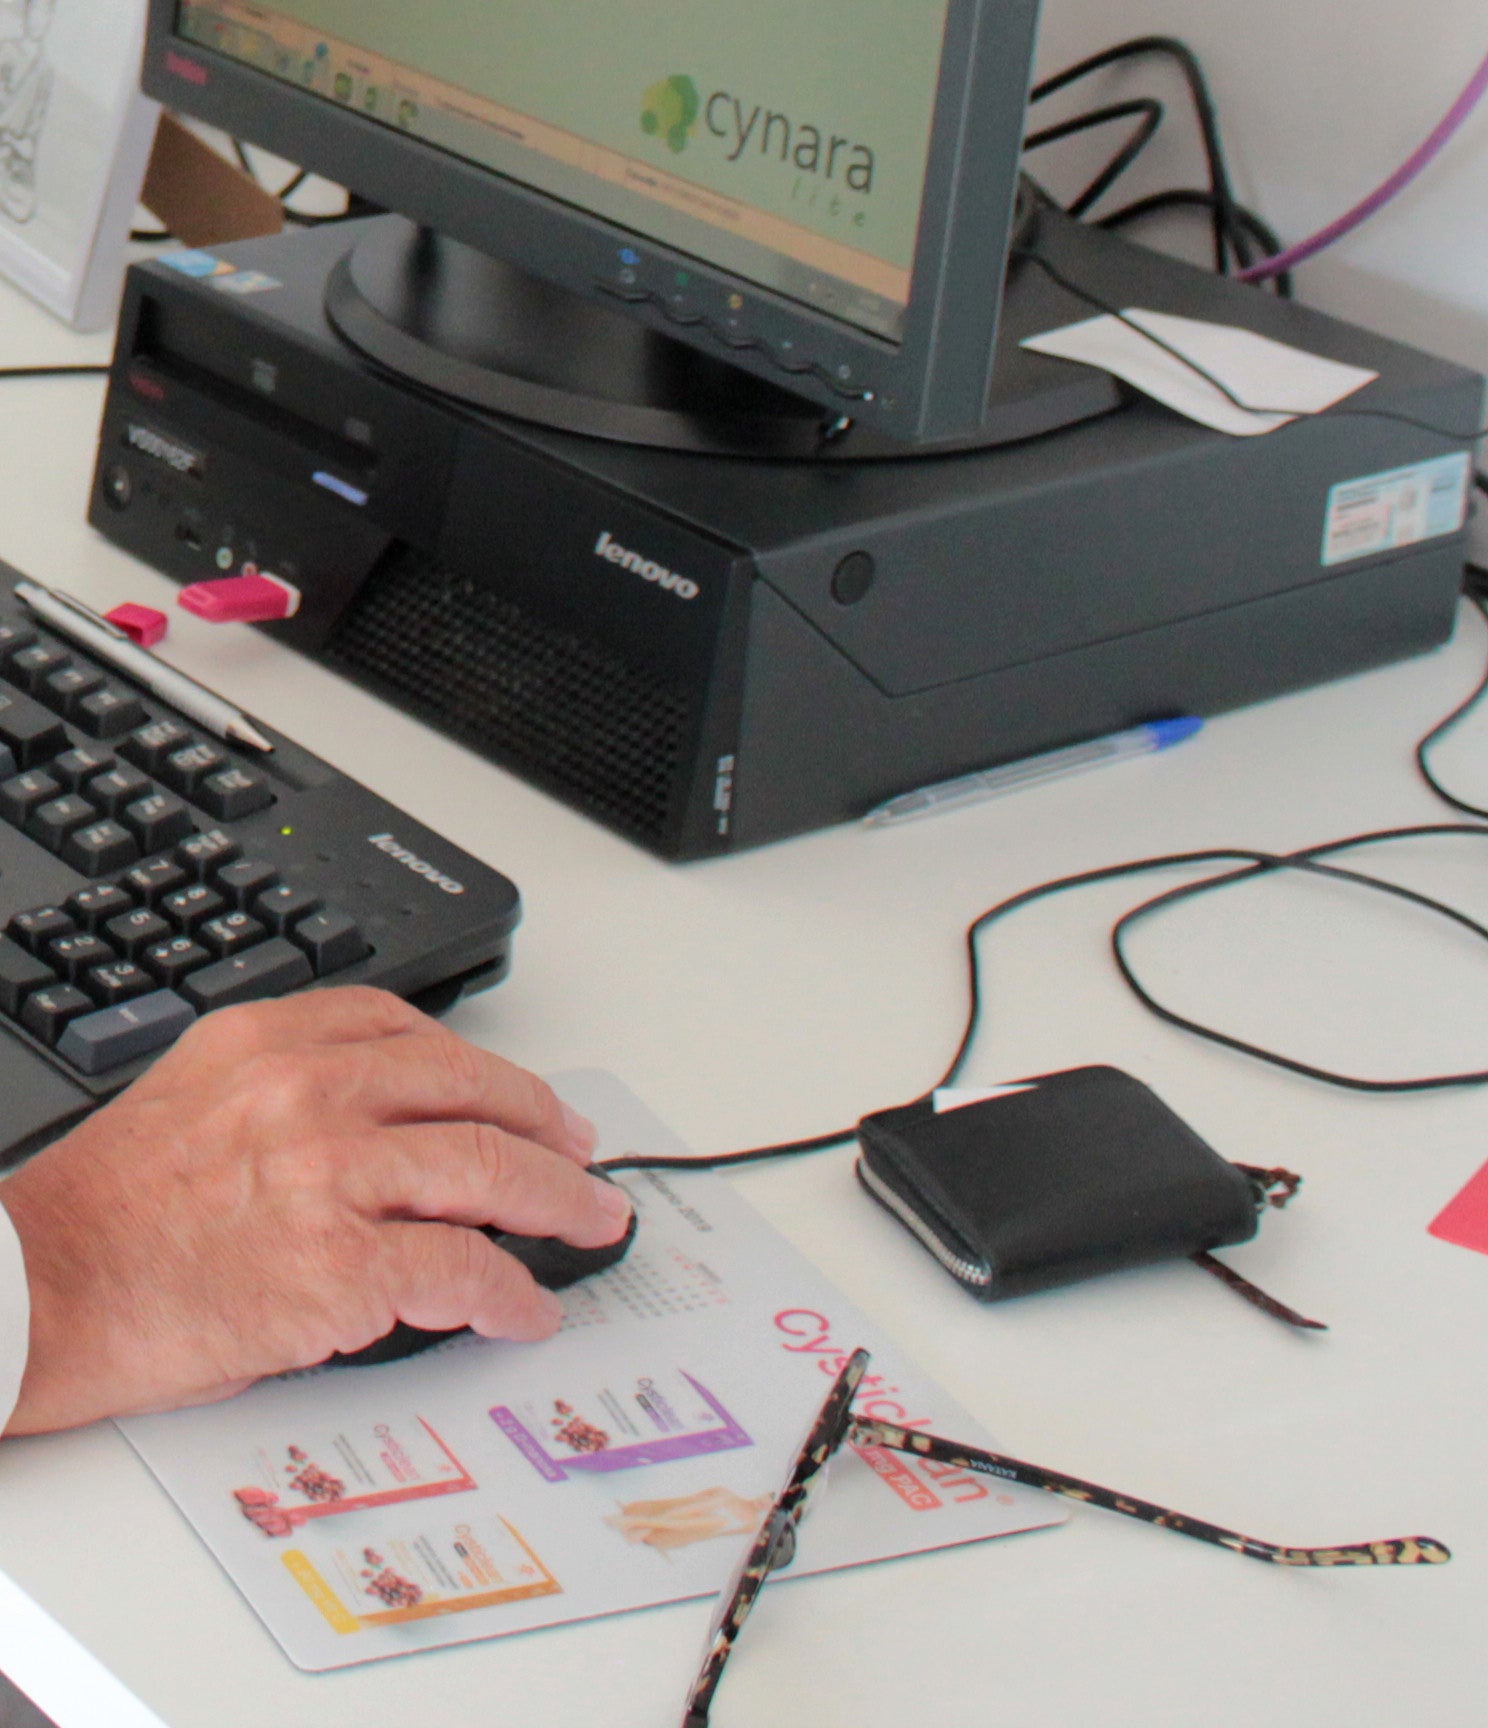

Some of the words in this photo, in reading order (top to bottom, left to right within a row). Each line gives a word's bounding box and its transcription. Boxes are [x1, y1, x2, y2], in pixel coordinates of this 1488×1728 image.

[706, 91, 875, 194] cynara
[792, 176, 866, 227] lite
[595, 531, 700, 600] lenovo
[149, 859, 170, 871] 7
[367, 832, 465, 894] lenovo
[97, 886, 114, 896] 4
[187, 887, 207, 900] 8
[37, 908, 55, 918] 1
[130, 911, 151, 925] 5
[226, 913, 247, 926] 9
[73, 936, 96, 948] 2
[171, 939, 191, 951] 6
[114, 964, 135, 976] 3
[773, 1308, 990, 1503] Cysticlan
[892, 1470, 937, 1508] PAC
